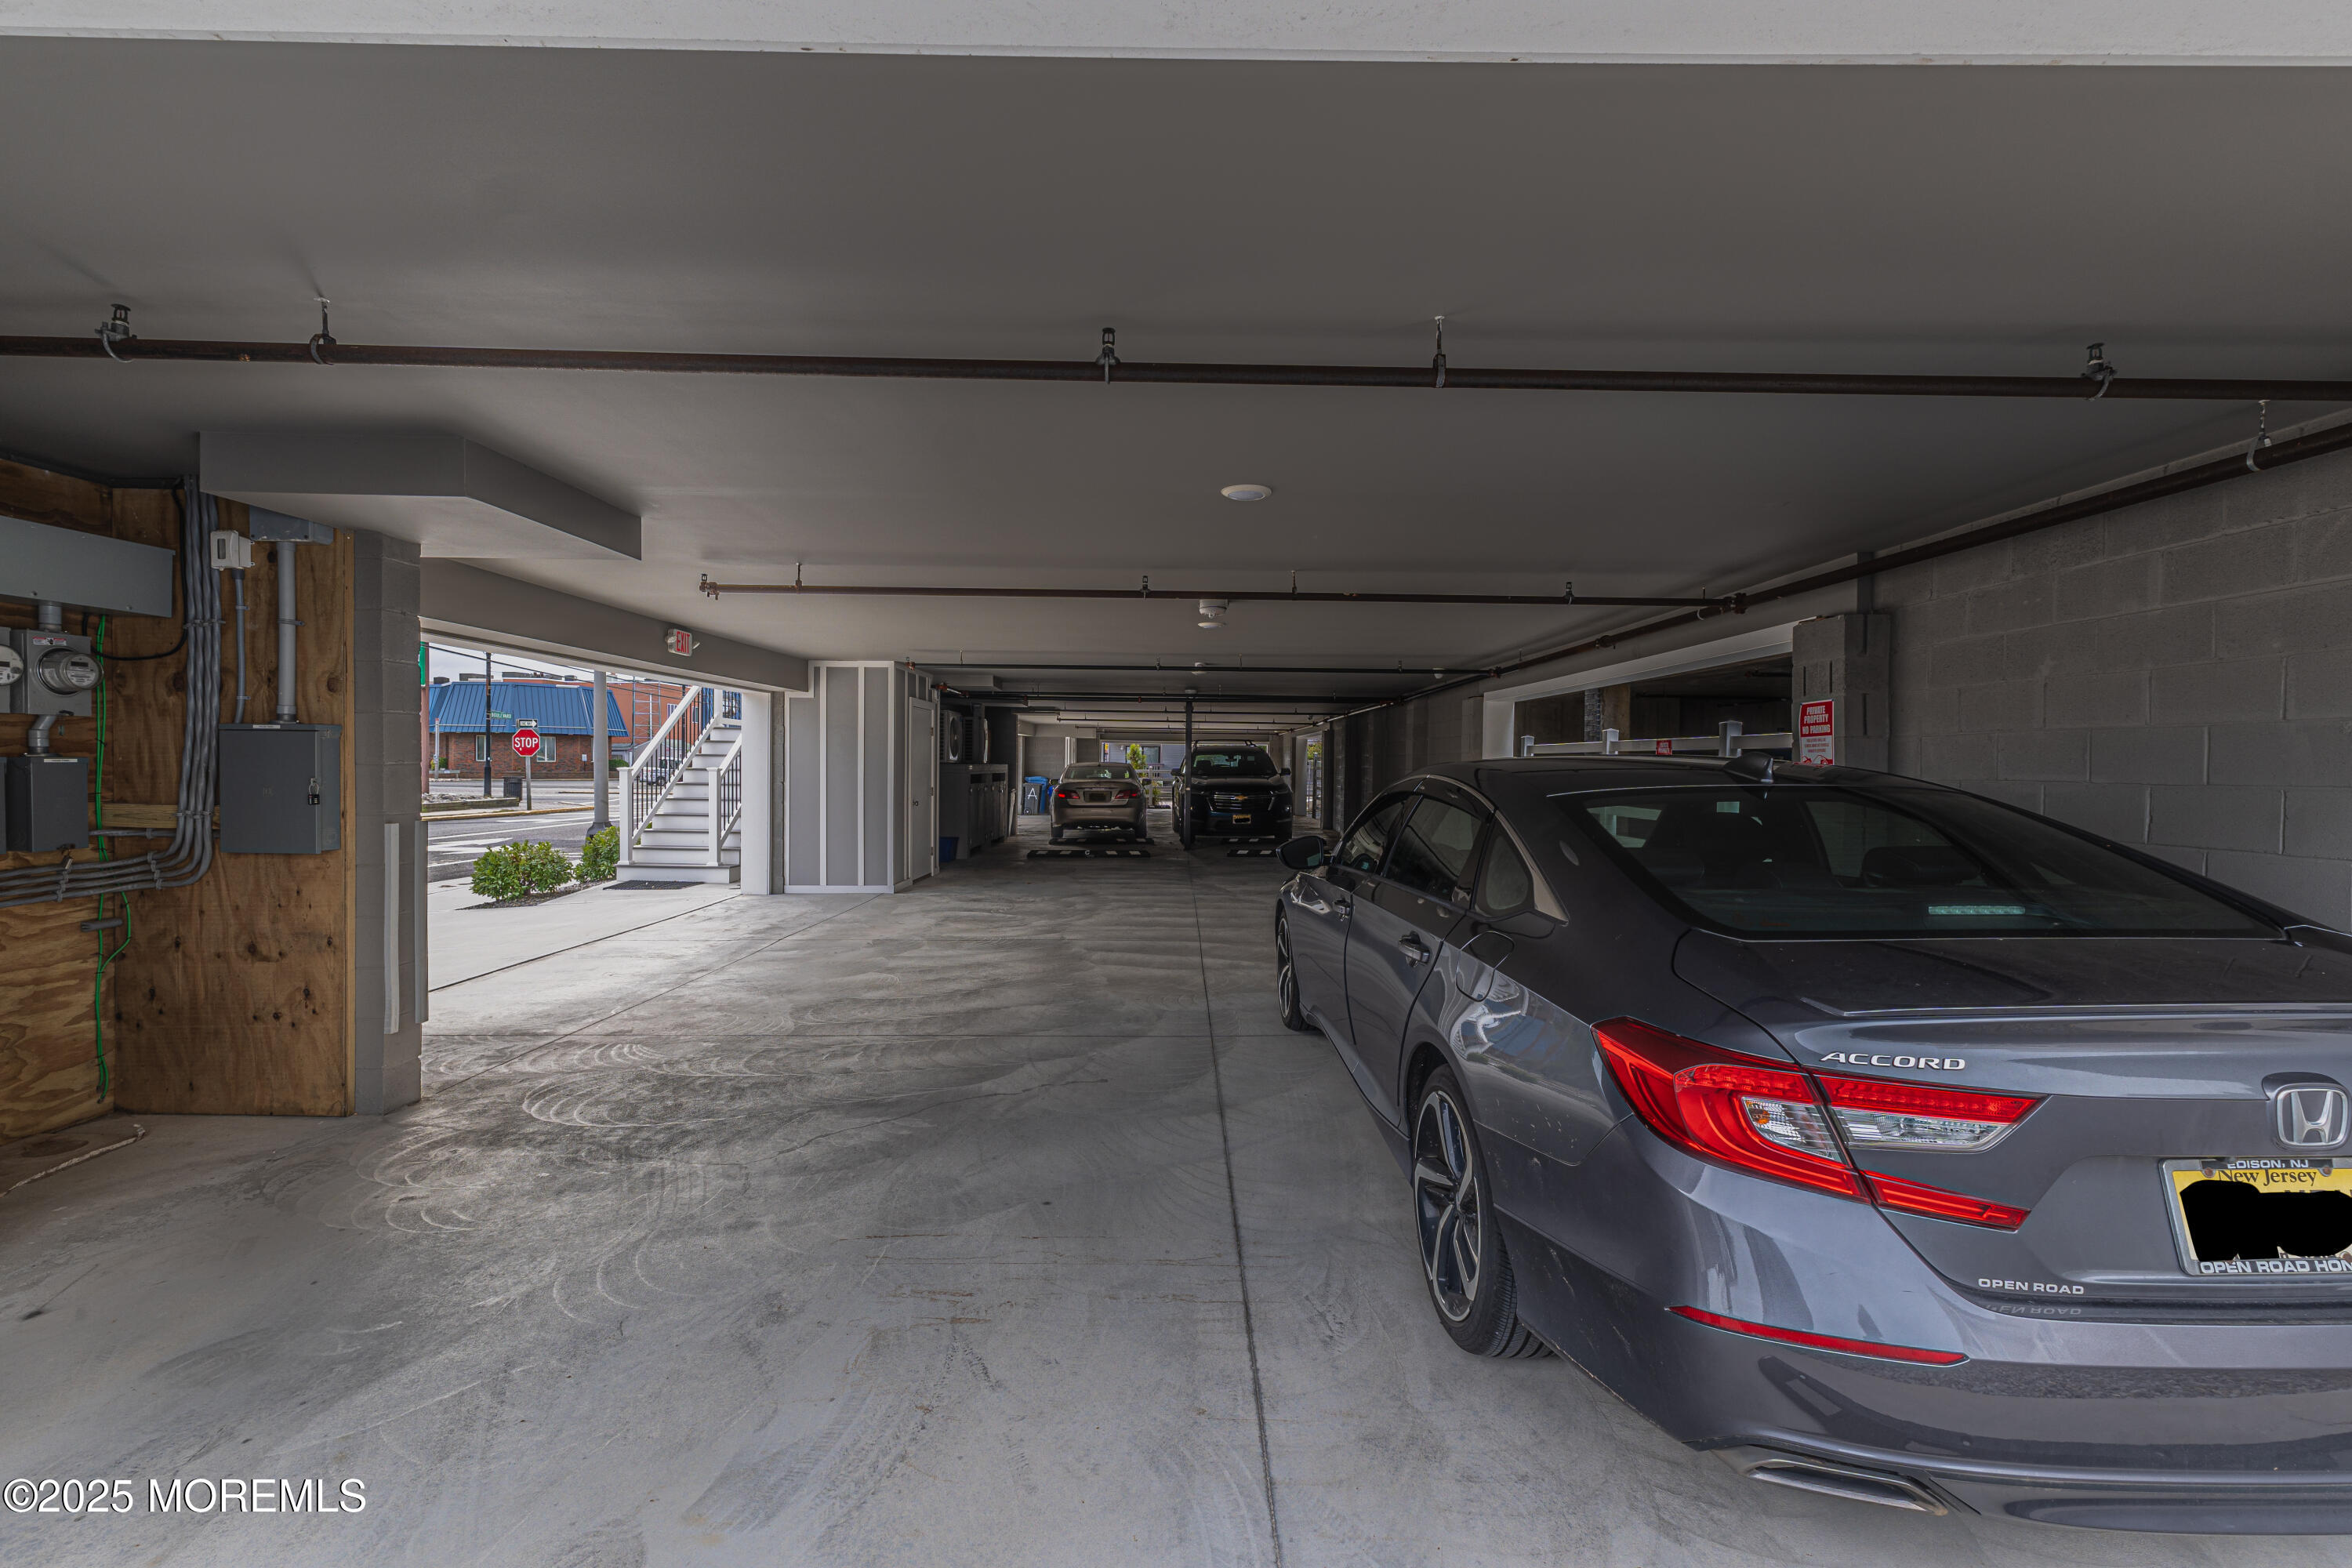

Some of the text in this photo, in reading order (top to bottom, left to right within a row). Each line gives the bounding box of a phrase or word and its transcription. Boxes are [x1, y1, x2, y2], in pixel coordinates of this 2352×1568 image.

[677, 631, 690, 653] EXIT
[1806, 706, 1826, 715] PRIVATE
[1803, 713, 1829, 724] PROPERTY
[1802, 724, 1831, 735] NO PARKING
[514, 737, 539, 748] STOP
[1027, 787, 1037, 800] A
[1820, 1051, 1965, 1071] ACCORD
[2290, 1160, 2309, 1169] NJ
[2219, 1168, 2317, 1187] New Jersey
[2201, 1260, 2256, 1274] OPEN
[2256, 1259, 2311, 1272] ROAD
[1978, 1278, 2085, 1295] OPEN ROAD
